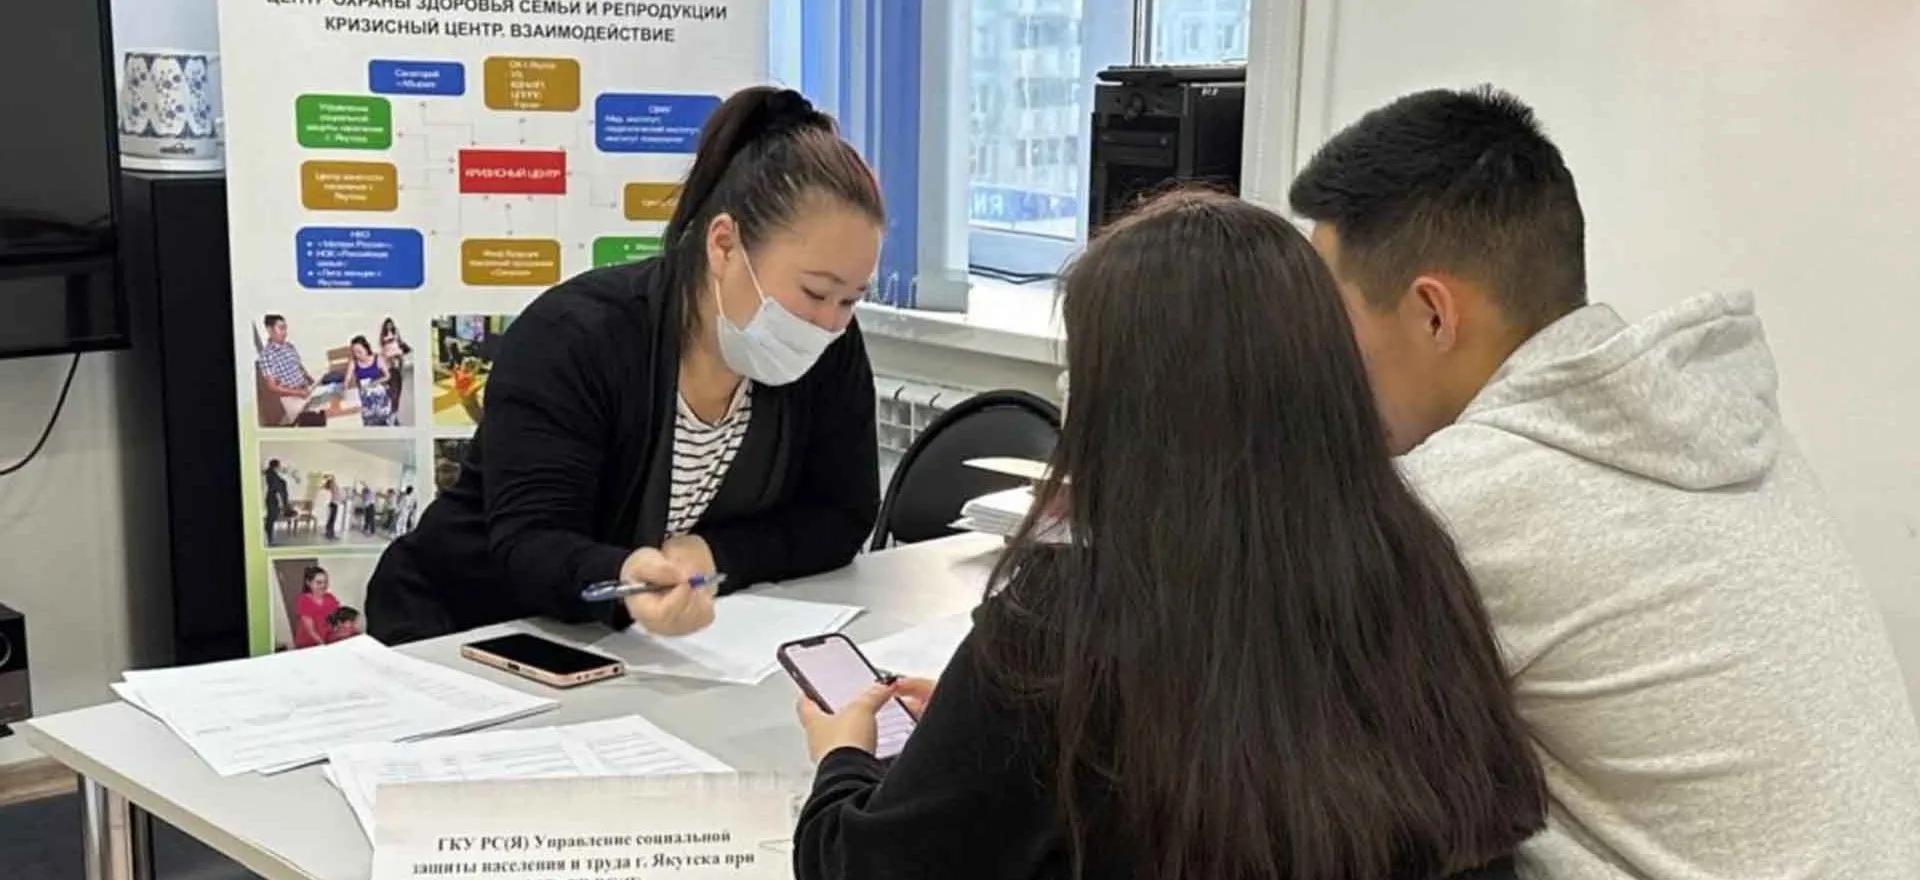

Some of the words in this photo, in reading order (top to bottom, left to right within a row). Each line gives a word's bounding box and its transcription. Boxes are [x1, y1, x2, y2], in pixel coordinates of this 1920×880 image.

[416, 0, 514, 12] ЗДОРОВЬЯ
[519, 0, 581, 15] СЕМЬИ
[585, 2, 598, 16] И
[602, 2, 728, 21] РЕПРОДУКЦИИ
[324, 16, 440, 35] КРИЗИСНЫЙ
[444, 21, 506, 38] ЦЕНТР.
[510, 23, 676, 42] ВЗАИМОДЕЙСТВИЕ
[465, 167, 527, 179] КРИЗИСНЫЙ
[528, 168, 561, 180] ЦЕНТР
[437, 835, 474, 851] ГКУ
[480, 834, 530, 852] РС(Я)
[535, 832, 632, 852] Управление
[635, 828, 731, 846] социальной
[412, 859, 477, 875] защиты
[481, 857, 566, 874] населения
[570, 857, 580, 871] и
[586, 855, 632, 875] труда
[635, 855, 649, 870] г.
[651, 851, 721, 871] Якутска
[724, 851, 755, 870] при
